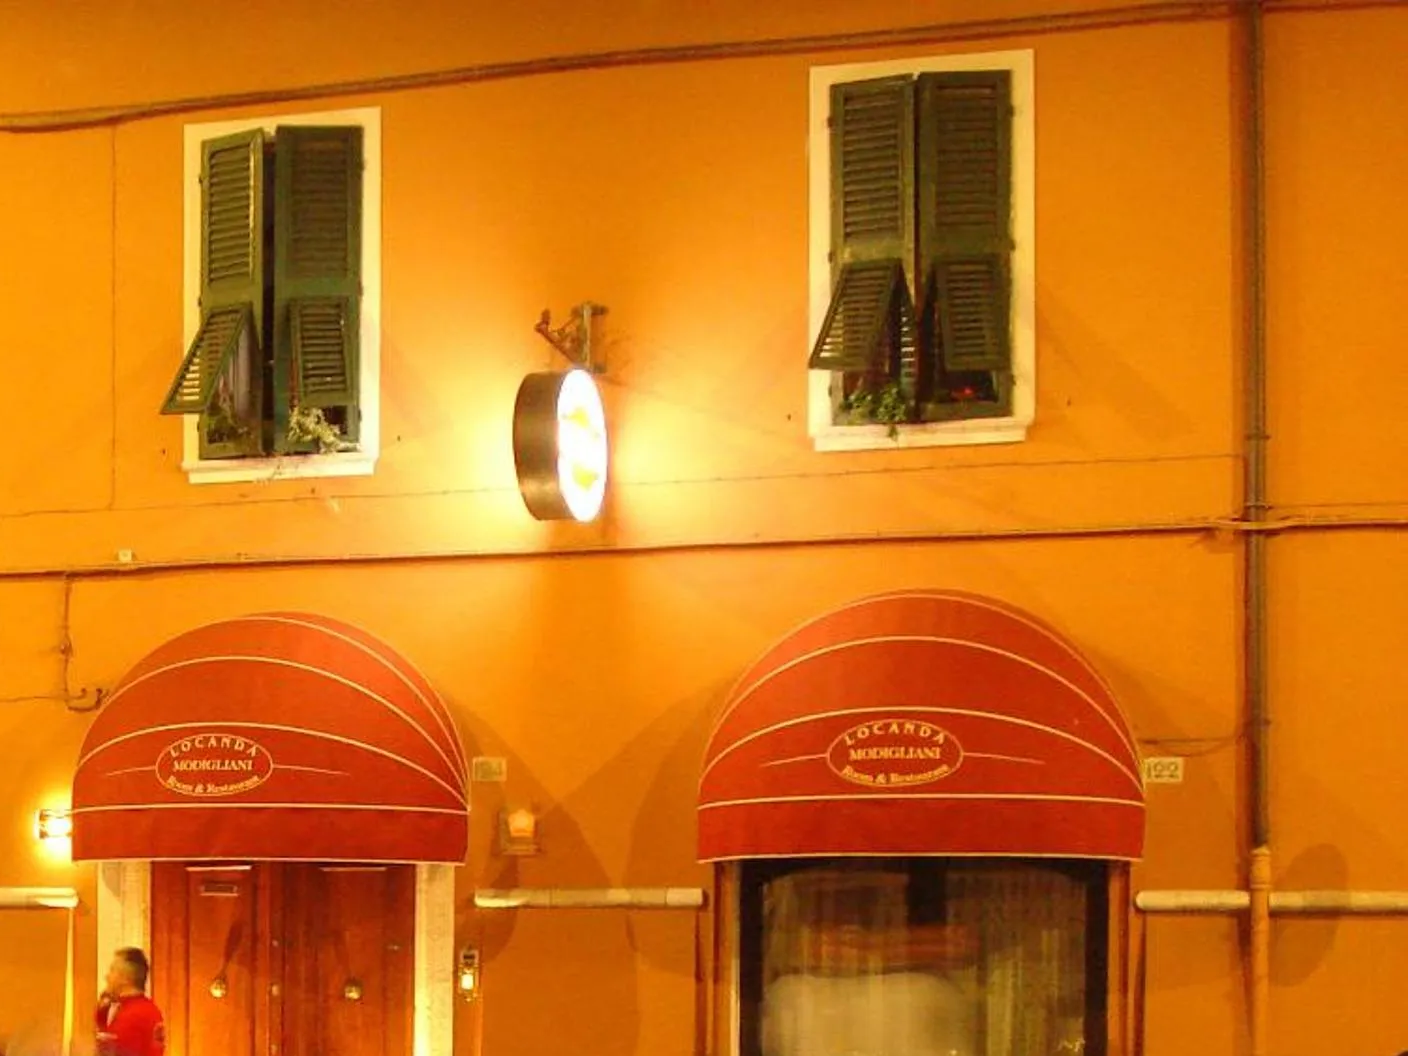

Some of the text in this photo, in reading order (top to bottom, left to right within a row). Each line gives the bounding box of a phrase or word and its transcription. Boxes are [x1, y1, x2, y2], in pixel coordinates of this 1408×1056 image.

[844, 722, 946, 746] LOCANDA
[170, 736, 258, 757] LOCANDA
[848, 747, 941, 761] MODIGLIANI
[174, 759, 253, 771] MODIGLIANI
